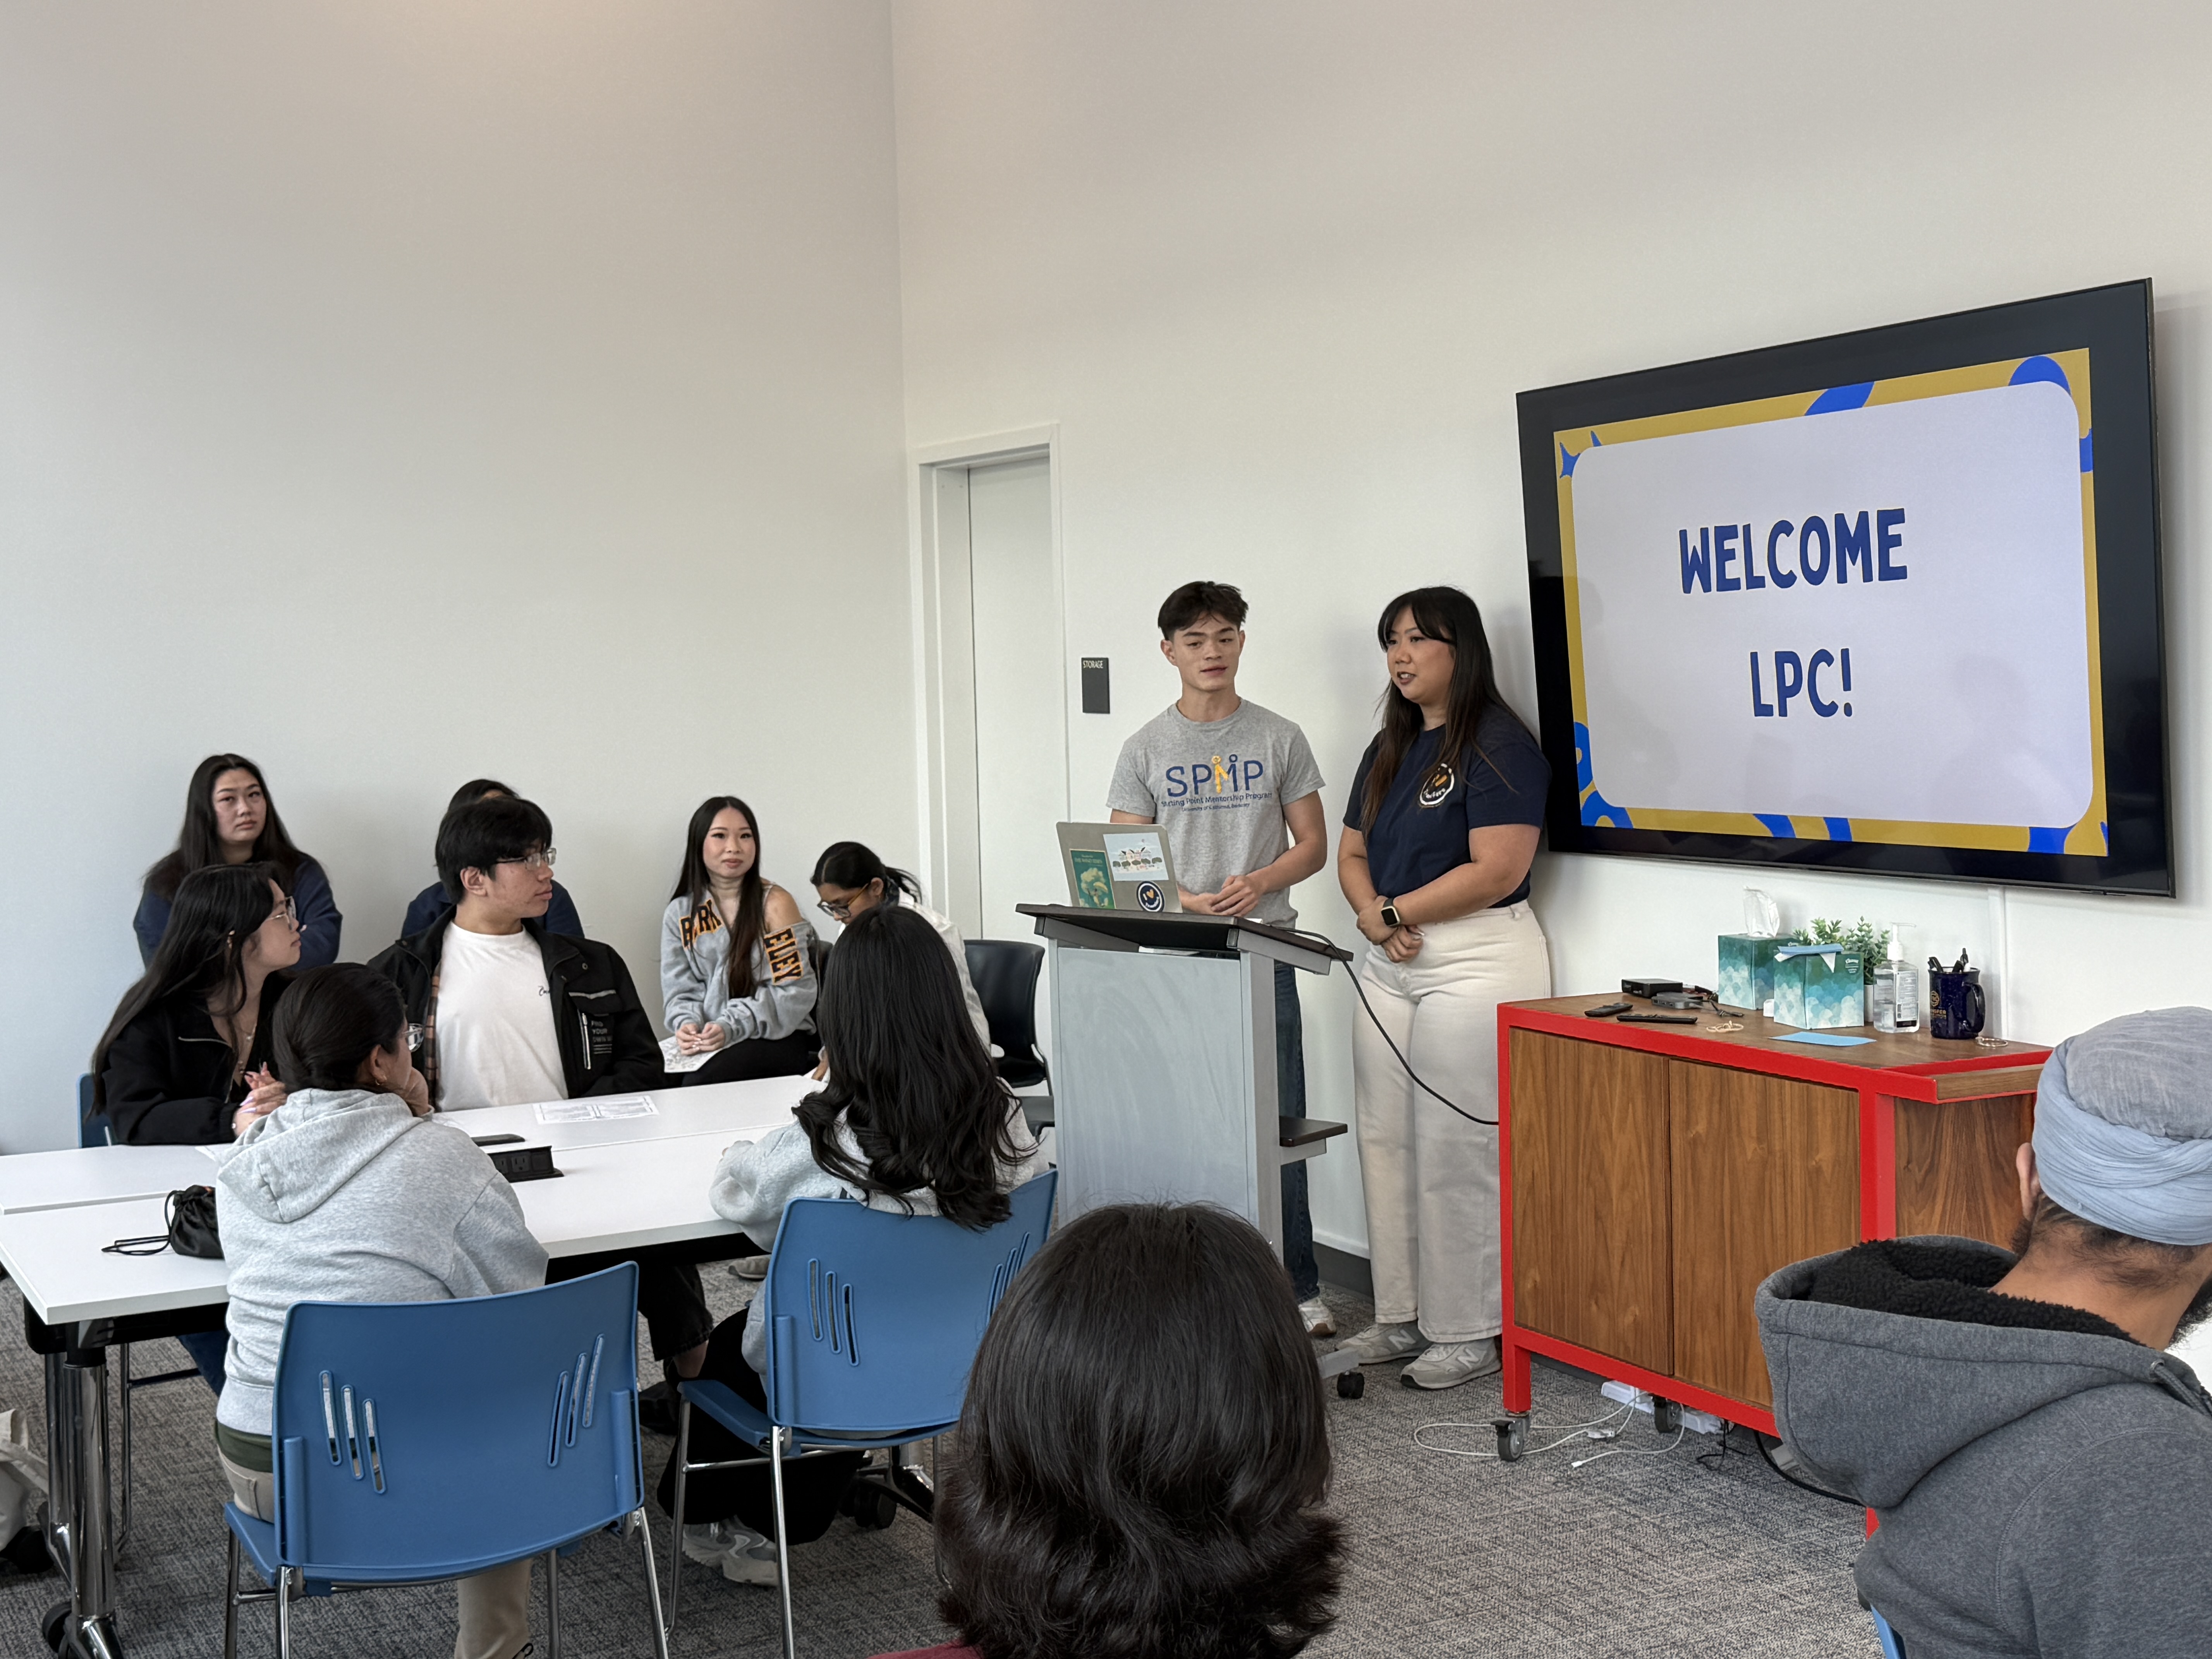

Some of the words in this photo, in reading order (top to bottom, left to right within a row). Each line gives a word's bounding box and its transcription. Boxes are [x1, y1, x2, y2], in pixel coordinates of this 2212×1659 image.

[1679, 508, 1908, 594] WELCOME
[1083, 660, 1103, 669] STORAGE
[1750, 648, 1853, 718] LPC!
[1165, 754, 1264, 797] SPMP
